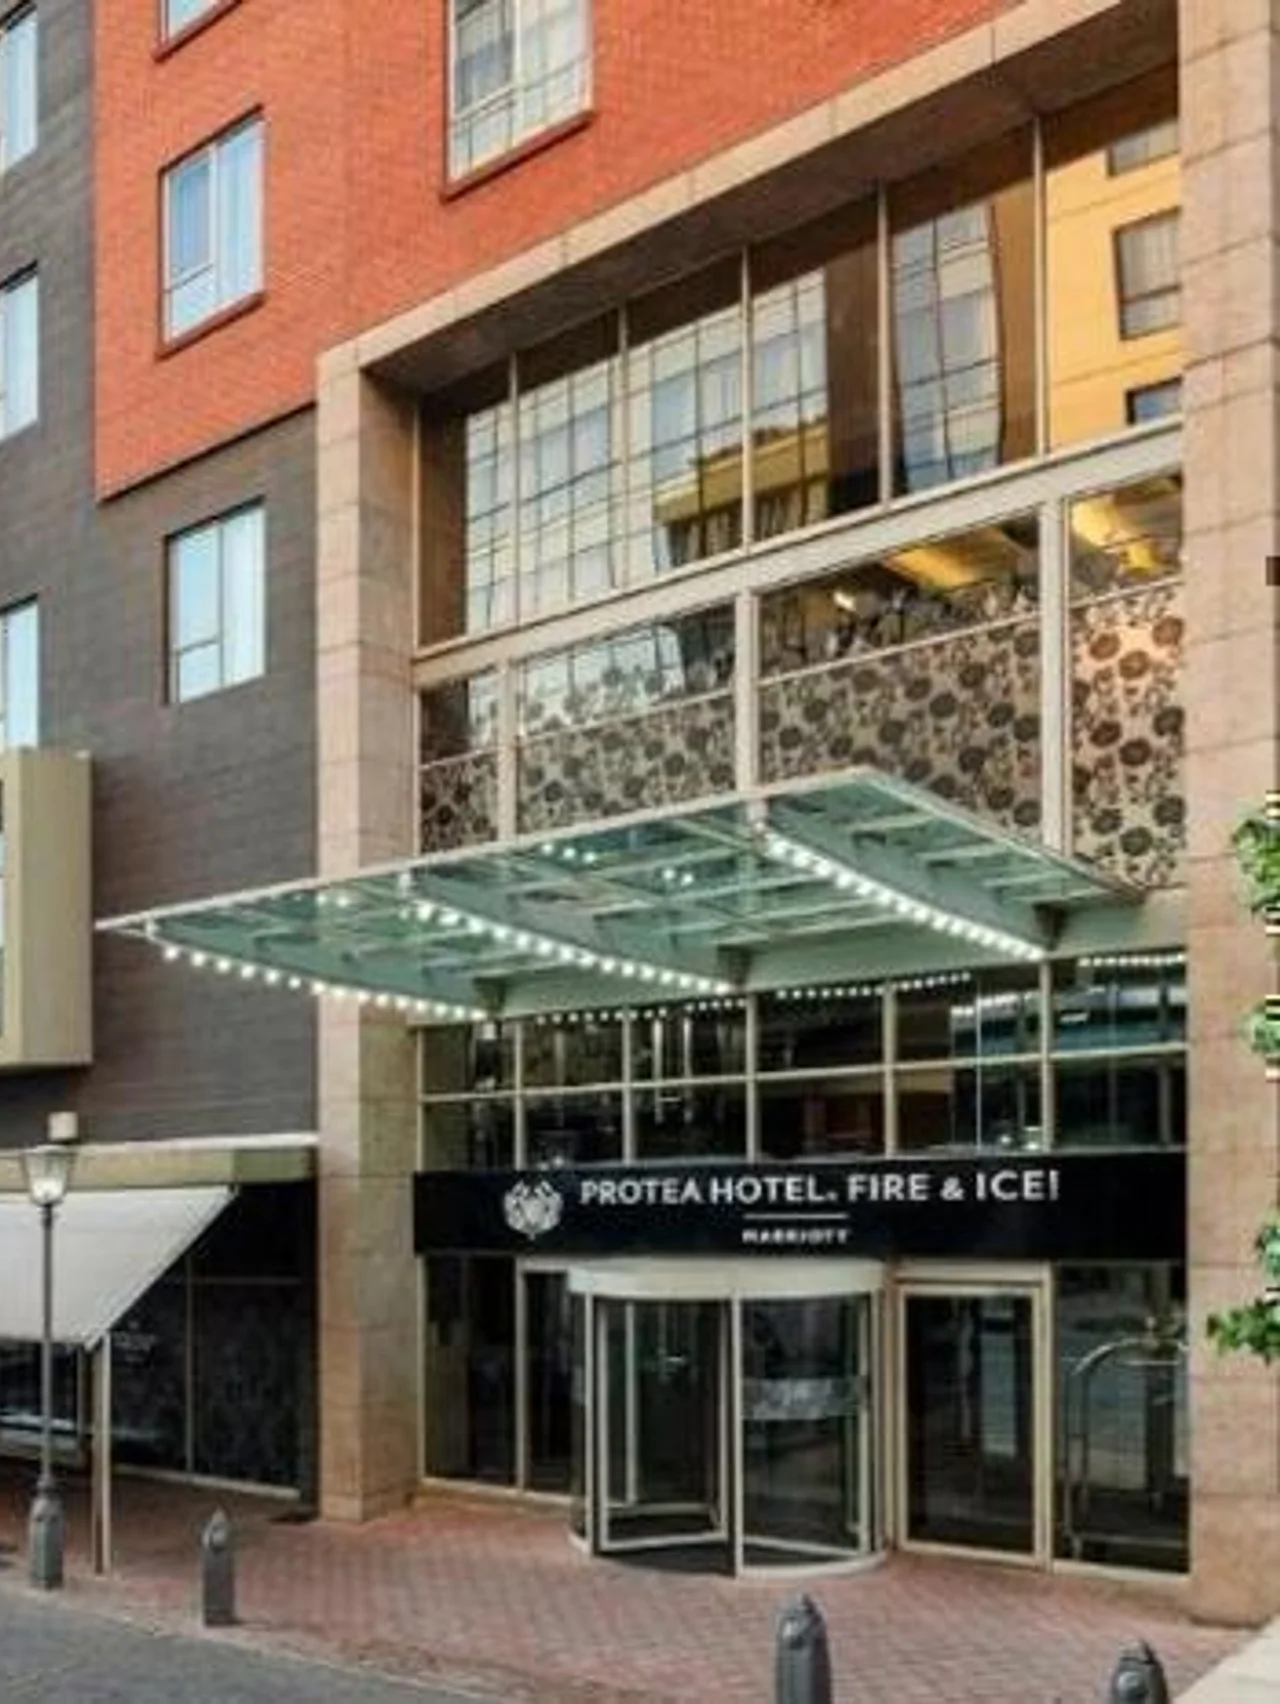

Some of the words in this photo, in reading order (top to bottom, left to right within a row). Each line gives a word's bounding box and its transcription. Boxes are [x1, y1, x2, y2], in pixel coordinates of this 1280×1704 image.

[580, 1178, 703, 1205] PROTEA
[847, 1173, 930, 1202] FIRE
[939, 1176, 965, 1201] &
[741, 1228, 850, 1245] MARRIOTT
